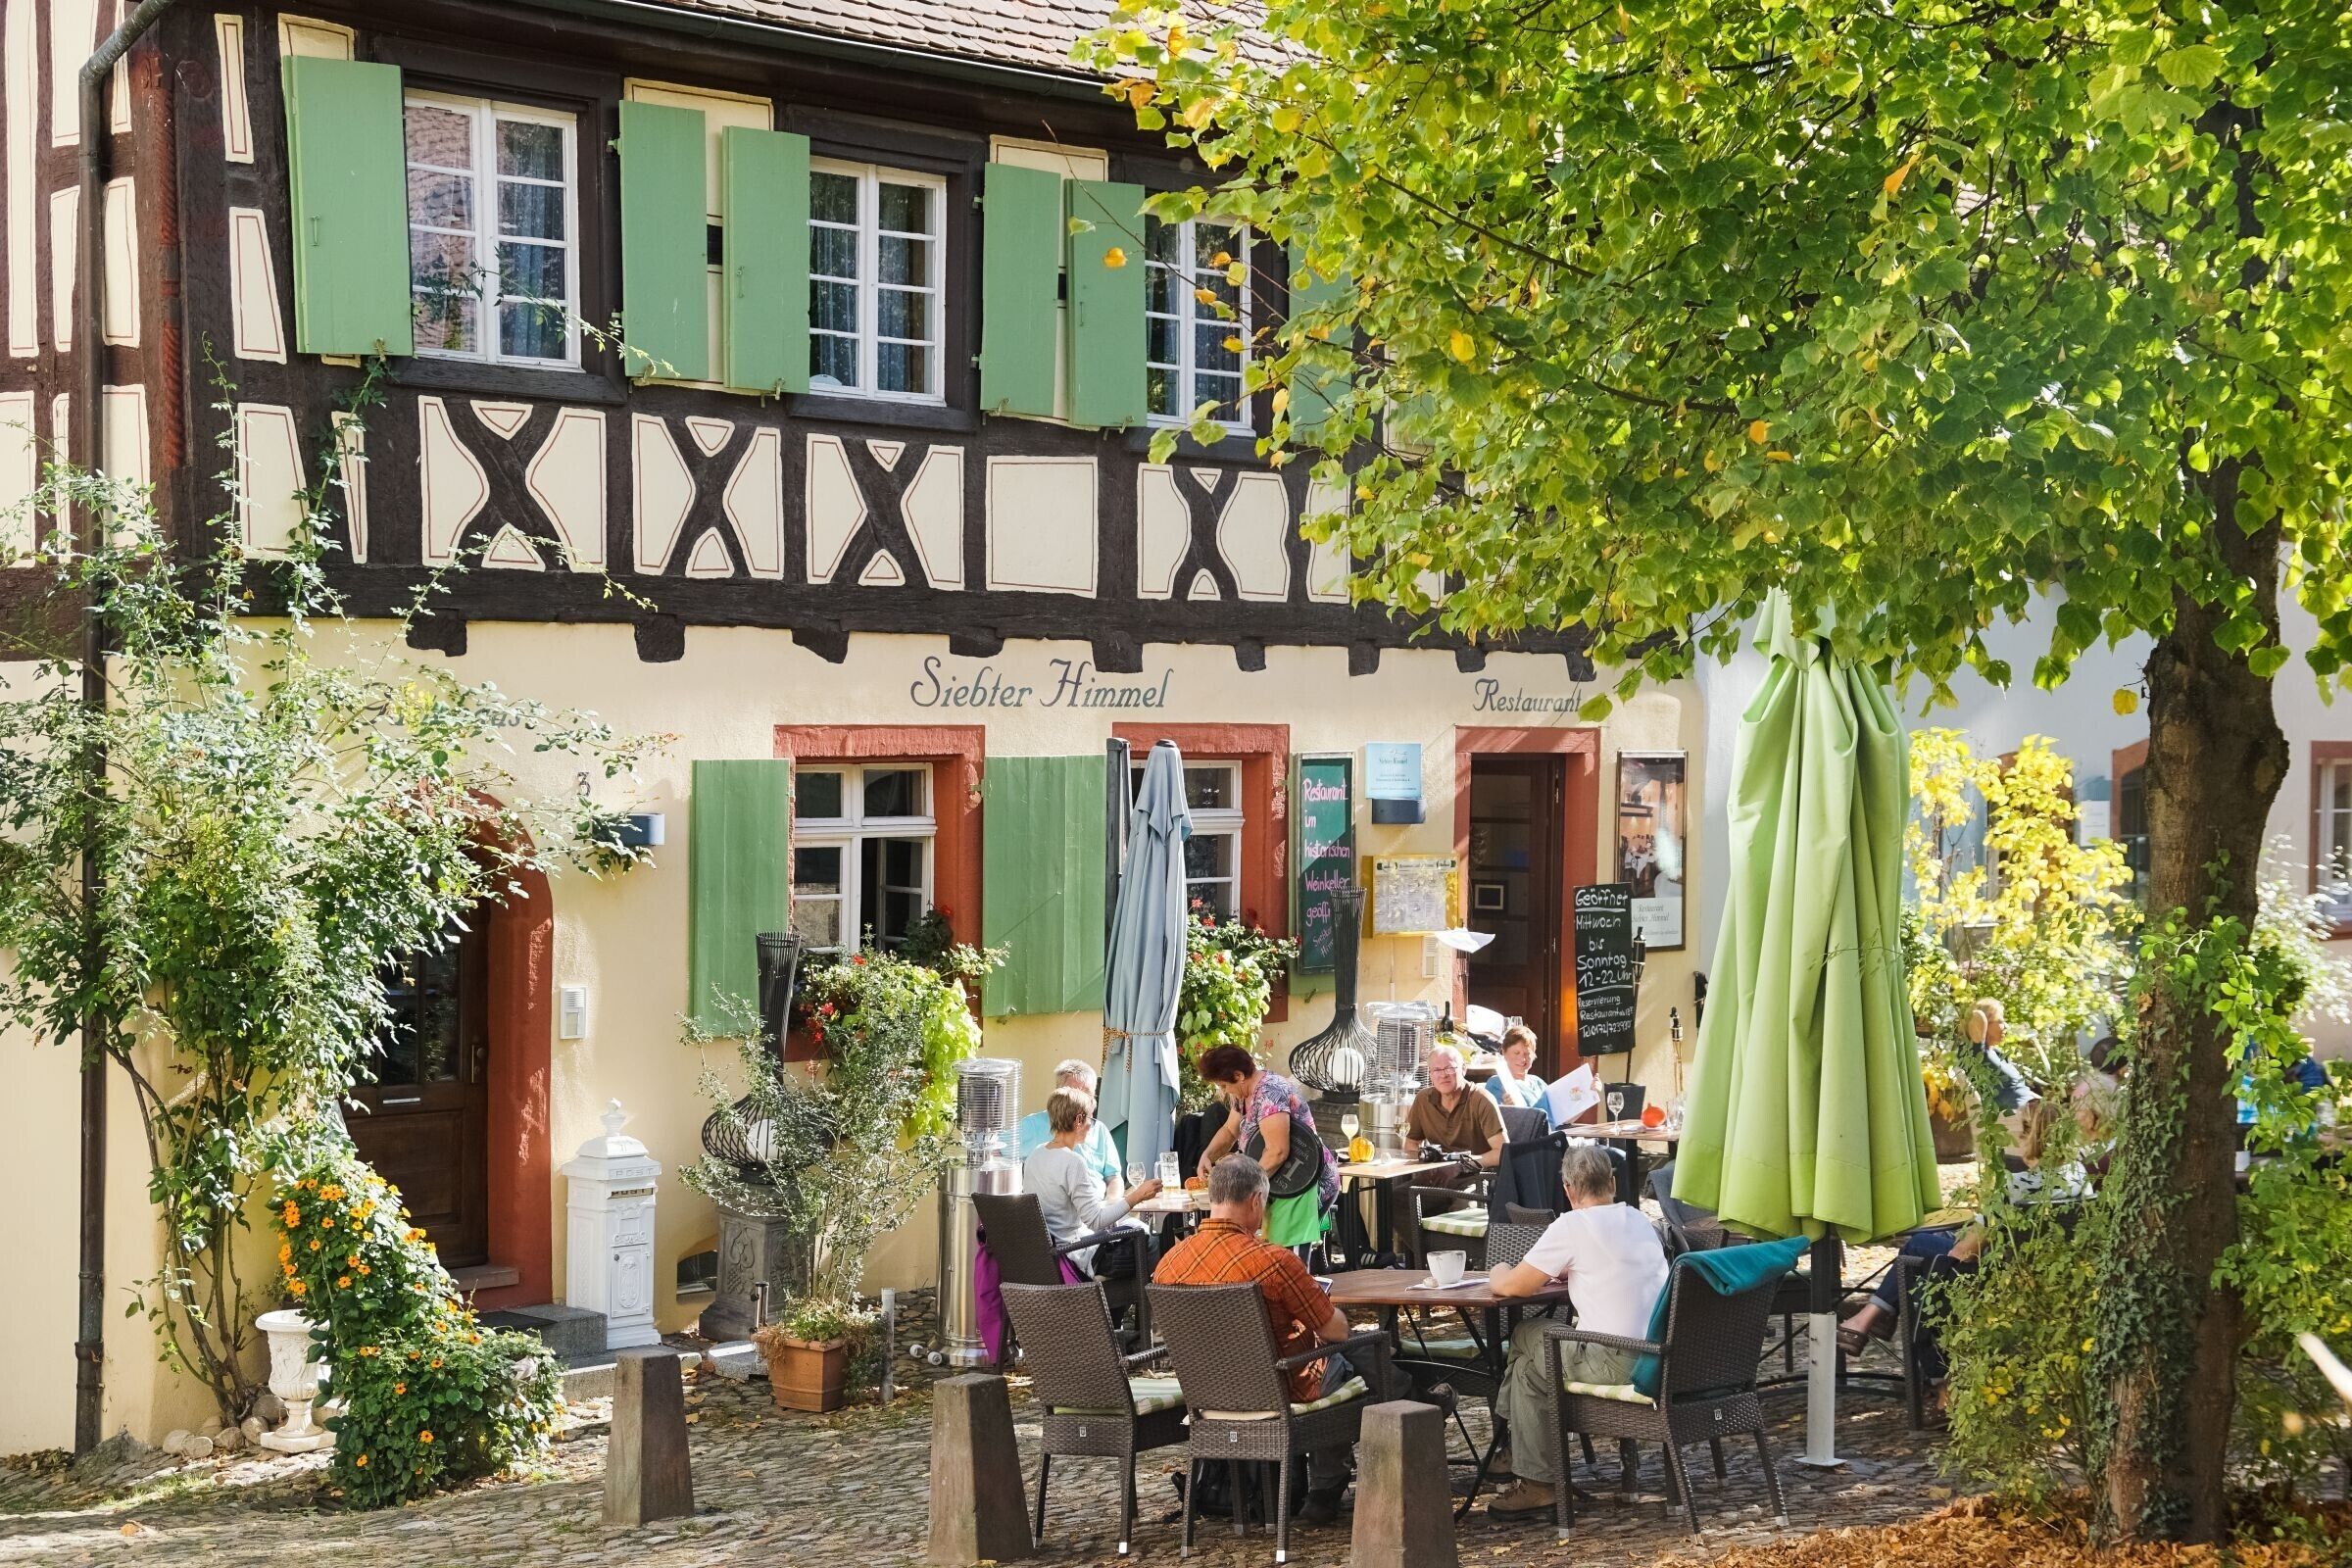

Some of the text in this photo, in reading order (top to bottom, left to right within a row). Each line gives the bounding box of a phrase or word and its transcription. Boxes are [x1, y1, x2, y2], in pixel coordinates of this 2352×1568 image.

[909, 656, 1174, 708] Siebter Himmel
[1473, 677, 1583, 712] Restaurant
[577, 771, 591, 796] 3
[1302, 778, 1349, 802] Restaurant
[1304, 809, 1316, 828] im
[1304, 839, 1350, 858] historischen
[1304, 869, 1349, 892] Weinkeller
[1575, 888, 1628, 906] Geöffnet
[1576, 913, 1622, 931] Mittwoch
[1589, 935, 1605, 952] bis
[1577, 952, 1627, 970] Sonntag
[1617, 969, 1632, 981] Uhr
[1578, 996, 1621, 1008] Reservierung
[1580, 1006, 1619, 1021] Restaurant
[615, 1167, 654, 1177] POST
